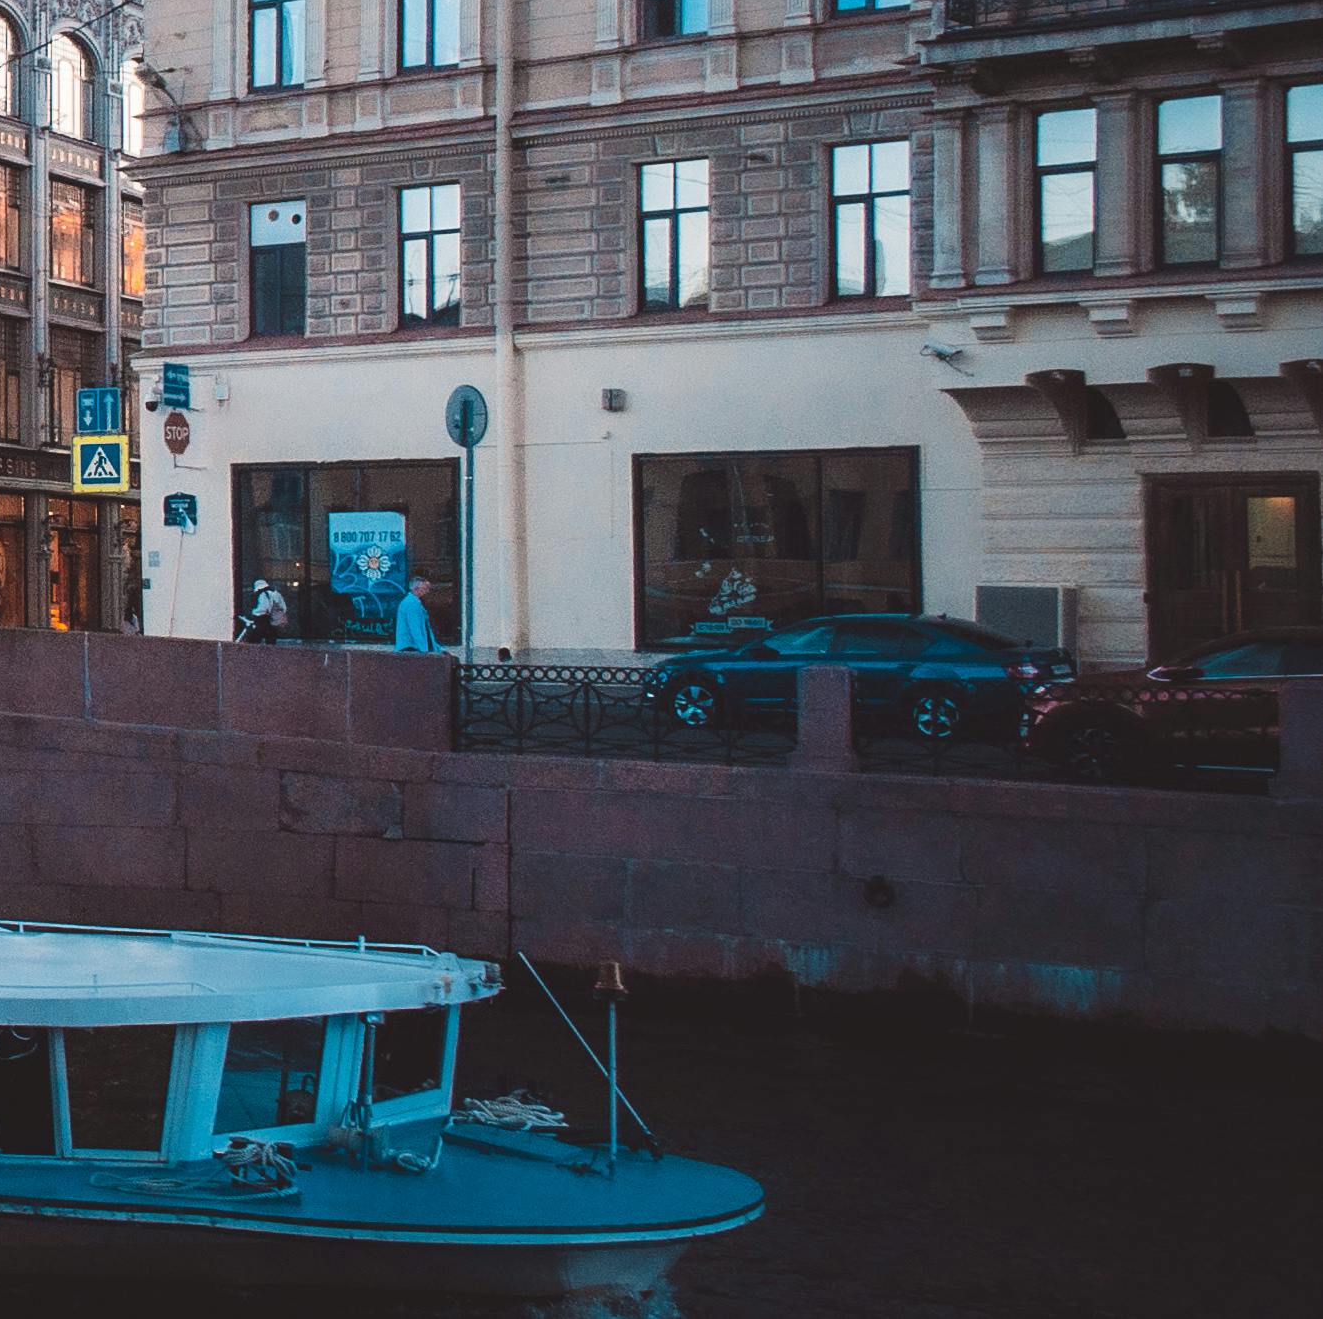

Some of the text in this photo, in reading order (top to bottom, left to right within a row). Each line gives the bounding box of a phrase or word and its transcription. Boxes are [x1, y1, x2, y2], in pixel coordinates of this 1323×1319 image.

[165, 425, 189, 441] STOP
[359, 531, 375, 543] 707
[378, 530, 389, 542] 17
